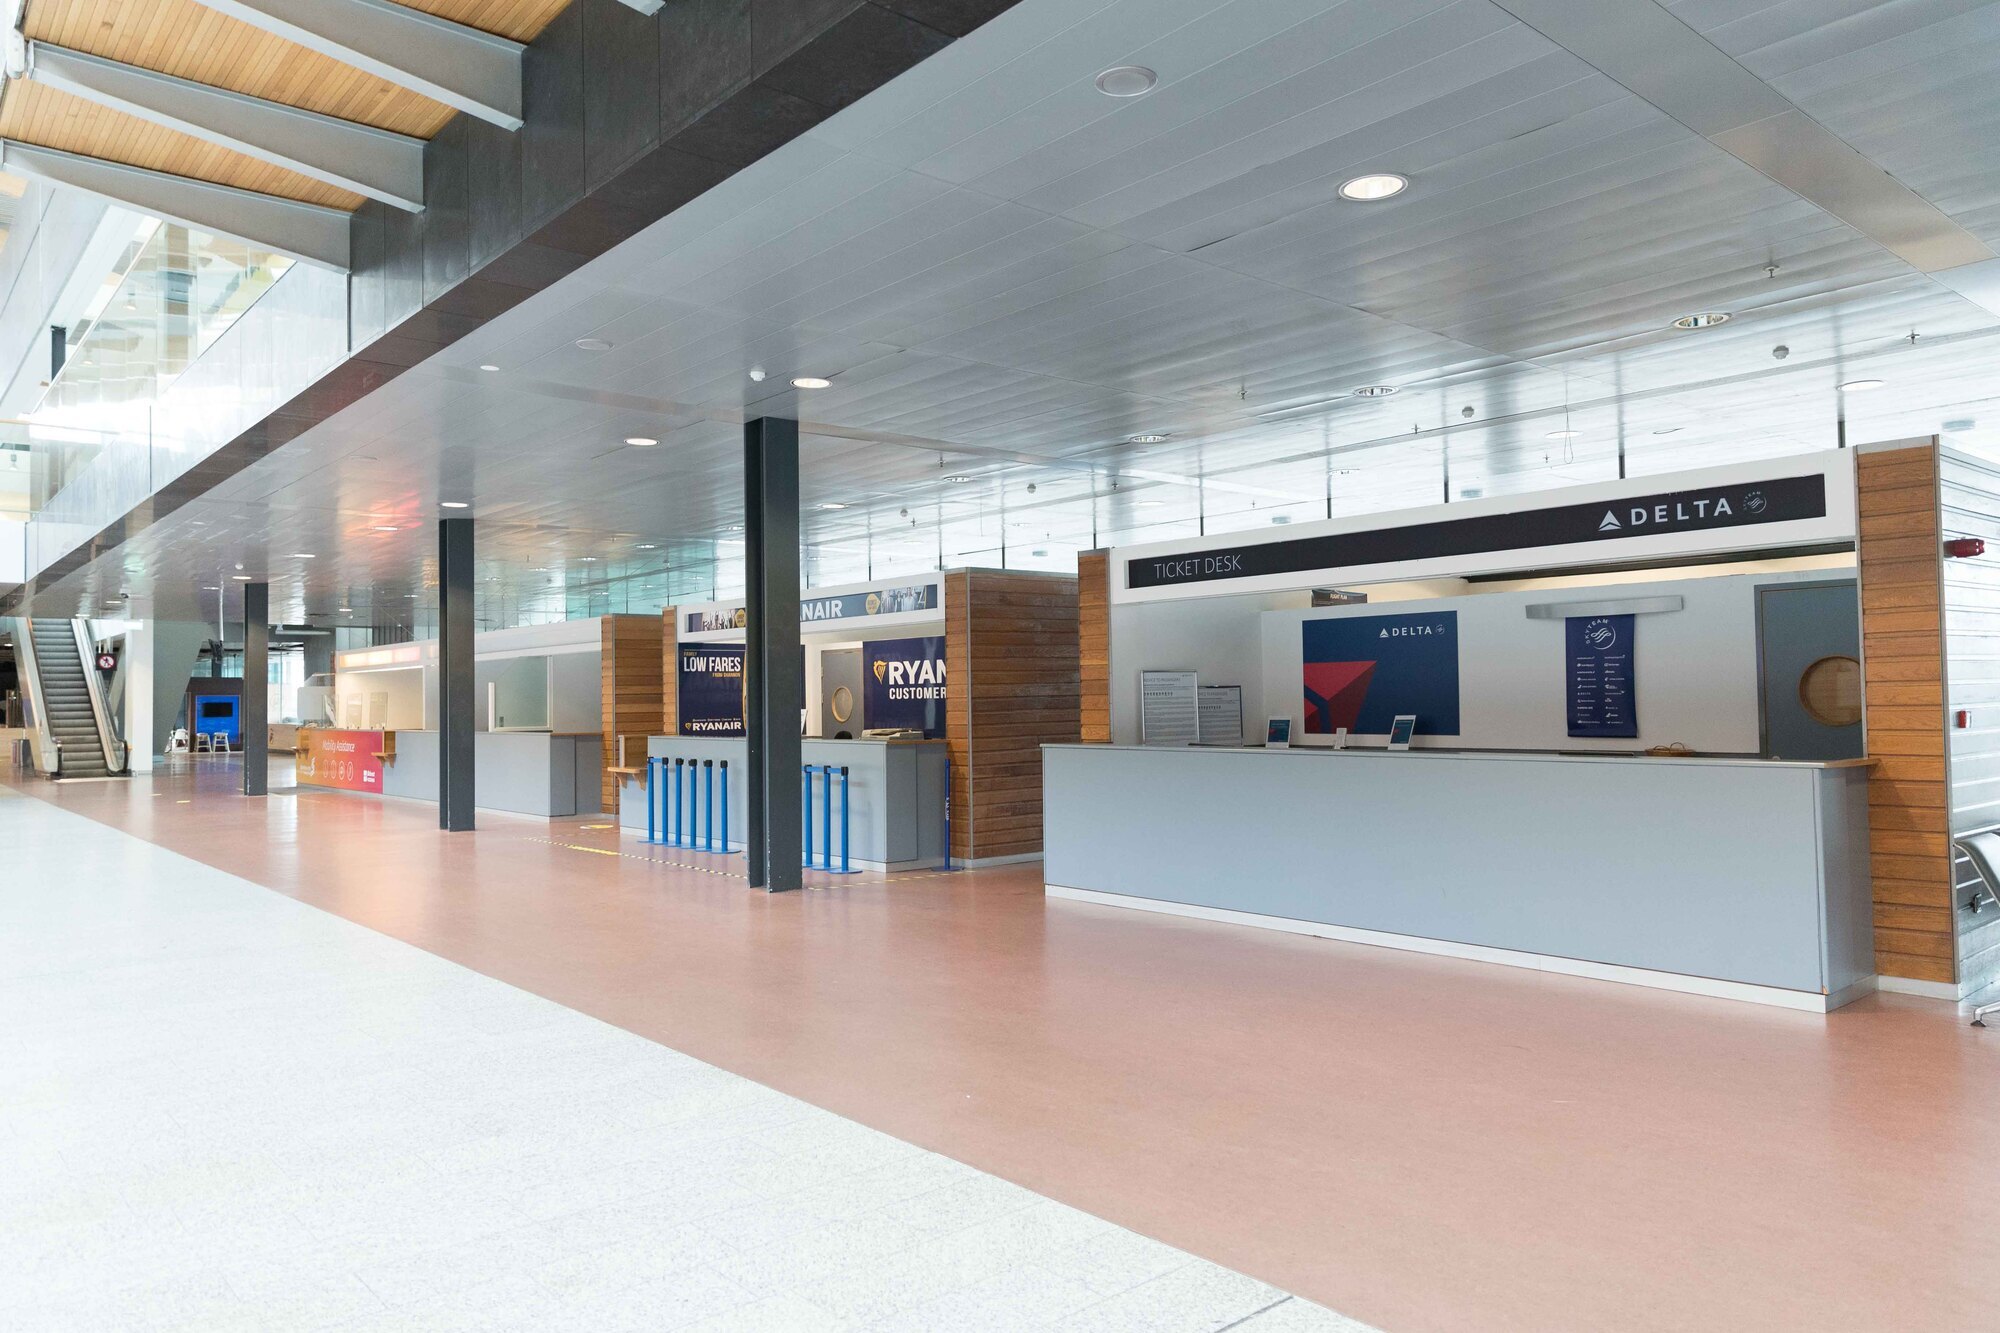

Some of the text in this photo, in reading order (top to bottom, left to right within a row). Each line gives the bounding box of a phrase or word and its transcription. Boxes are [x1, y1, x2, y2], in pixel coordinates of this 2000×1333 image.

[1630, 498, 1732, 526] DELTA
[1154, 554, 1242, 579] TICKET DESK
[800, 600, 843, 621] NAIR
[1392, 626, 1432, 637] DELTA
[1584, 618, 1609, 645] SKYTEAM
[683, 656, 741, 672] LOW FARES
[889, 687, 946, 700] CUSTOMER
[692, 721, 742, 731] RYANAIR
